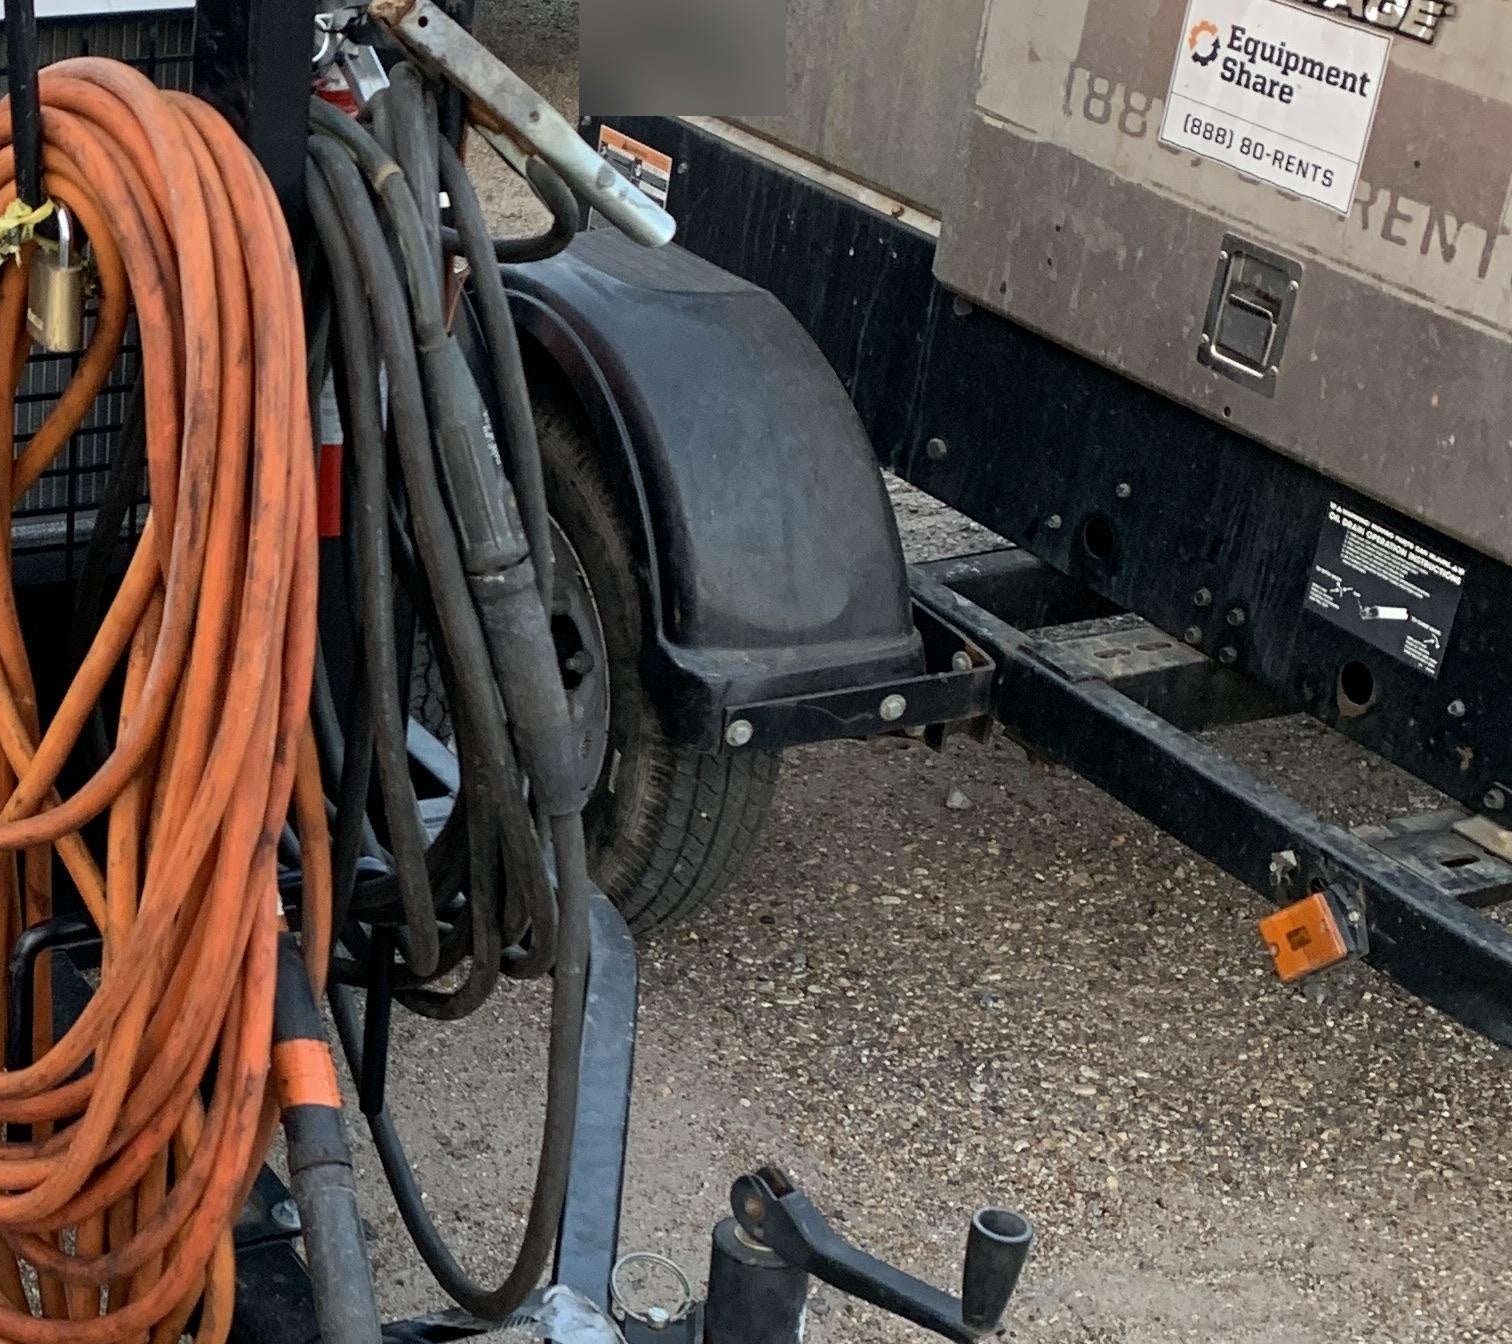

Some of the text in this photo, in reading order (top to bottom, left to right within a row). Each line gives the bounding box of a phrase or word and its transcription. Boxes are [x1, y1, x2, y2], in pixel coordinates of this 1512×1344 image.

[1219, 56, 1295, 105] Share
[1226, 24, 1371, 98] Equipment
[1183, 113, 1336, 189] (888) 80-RENTS
